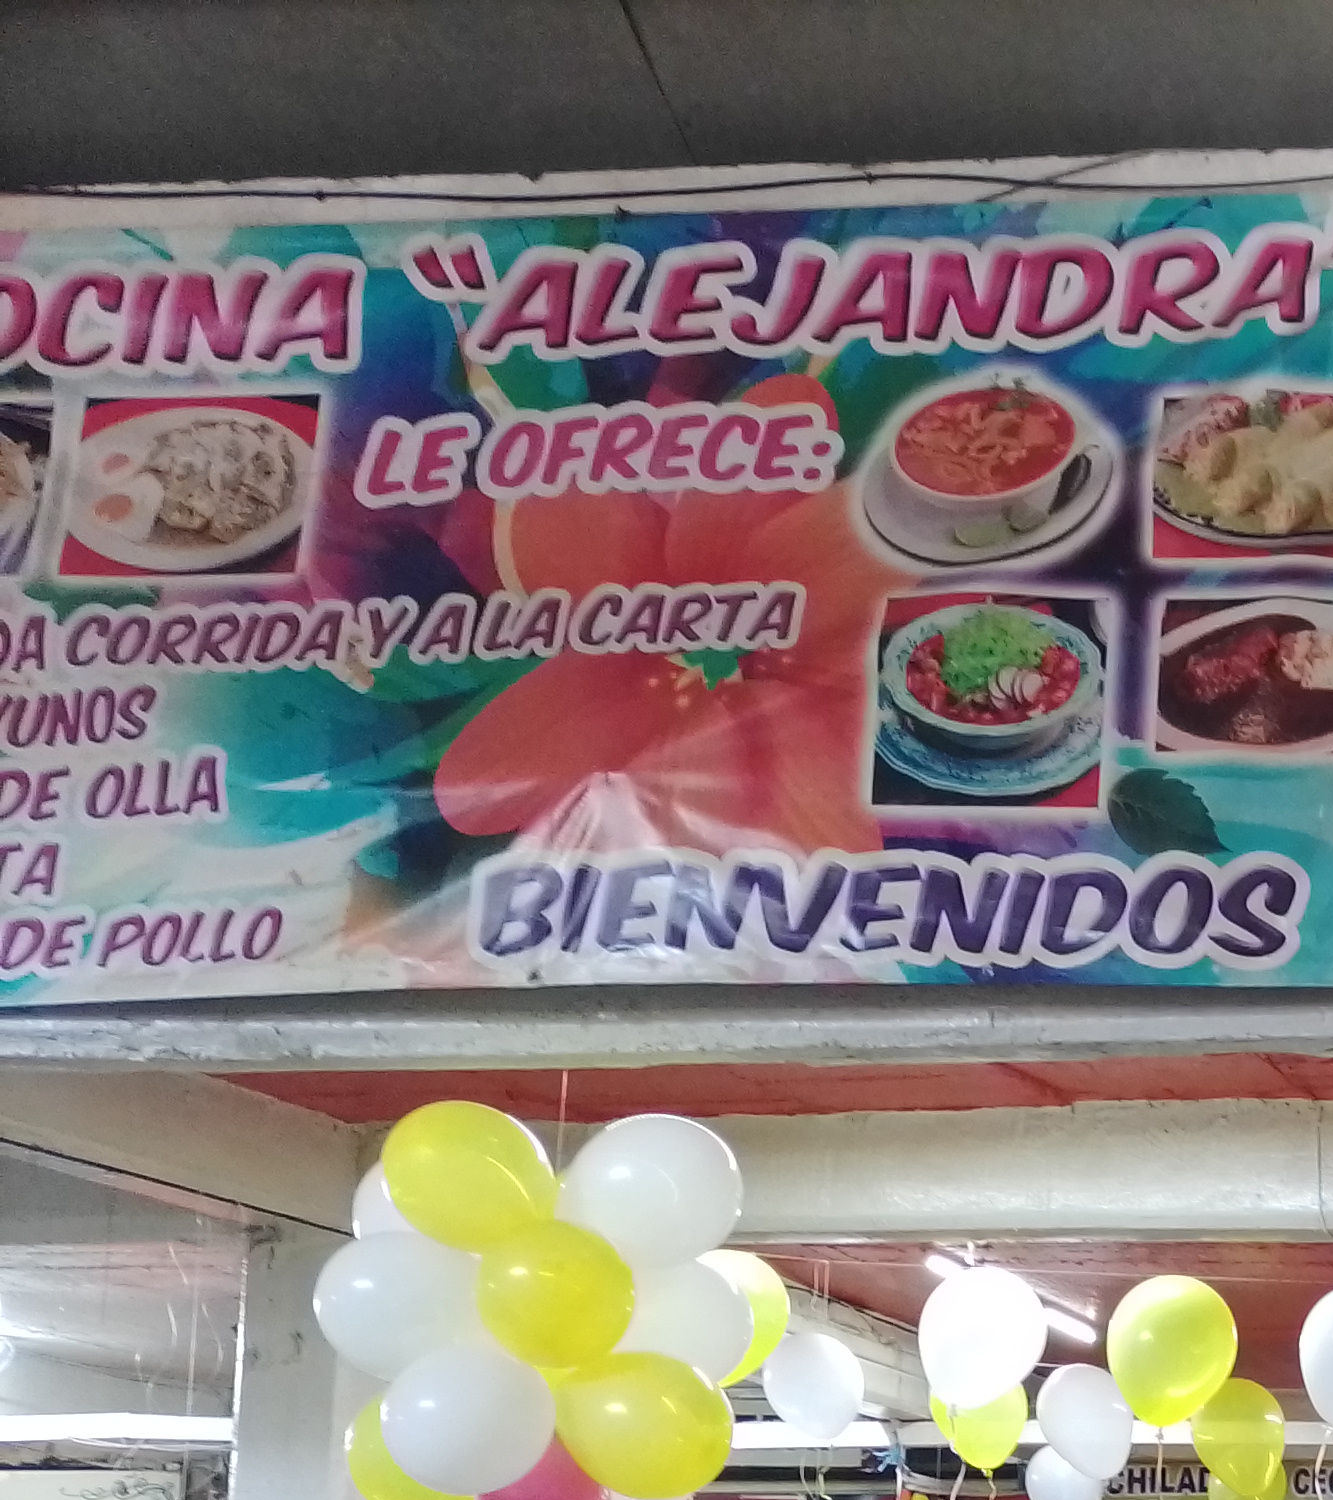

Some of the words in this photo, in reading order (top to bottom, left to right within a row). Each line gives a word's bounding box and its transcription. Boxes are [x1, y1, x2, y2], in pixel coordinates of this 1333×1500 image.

[367, 424, 470, 497] LE
[488, 410, 834, 485] OFRECE:
[66, 608, 341, 667] CORRIDA
[366, 604, 404, 662] Y
[414, 597, 470, 656] A
[474, 594, 563, 653] LA
[582, 589, 797, 647] CARTA
[85, 756, 219, 819] OLLA
[2, 915, 86, 970] DE
[97, 906, 283, 967] POLLO
[479, 862, 1299, 960] BIENVENIDOS
